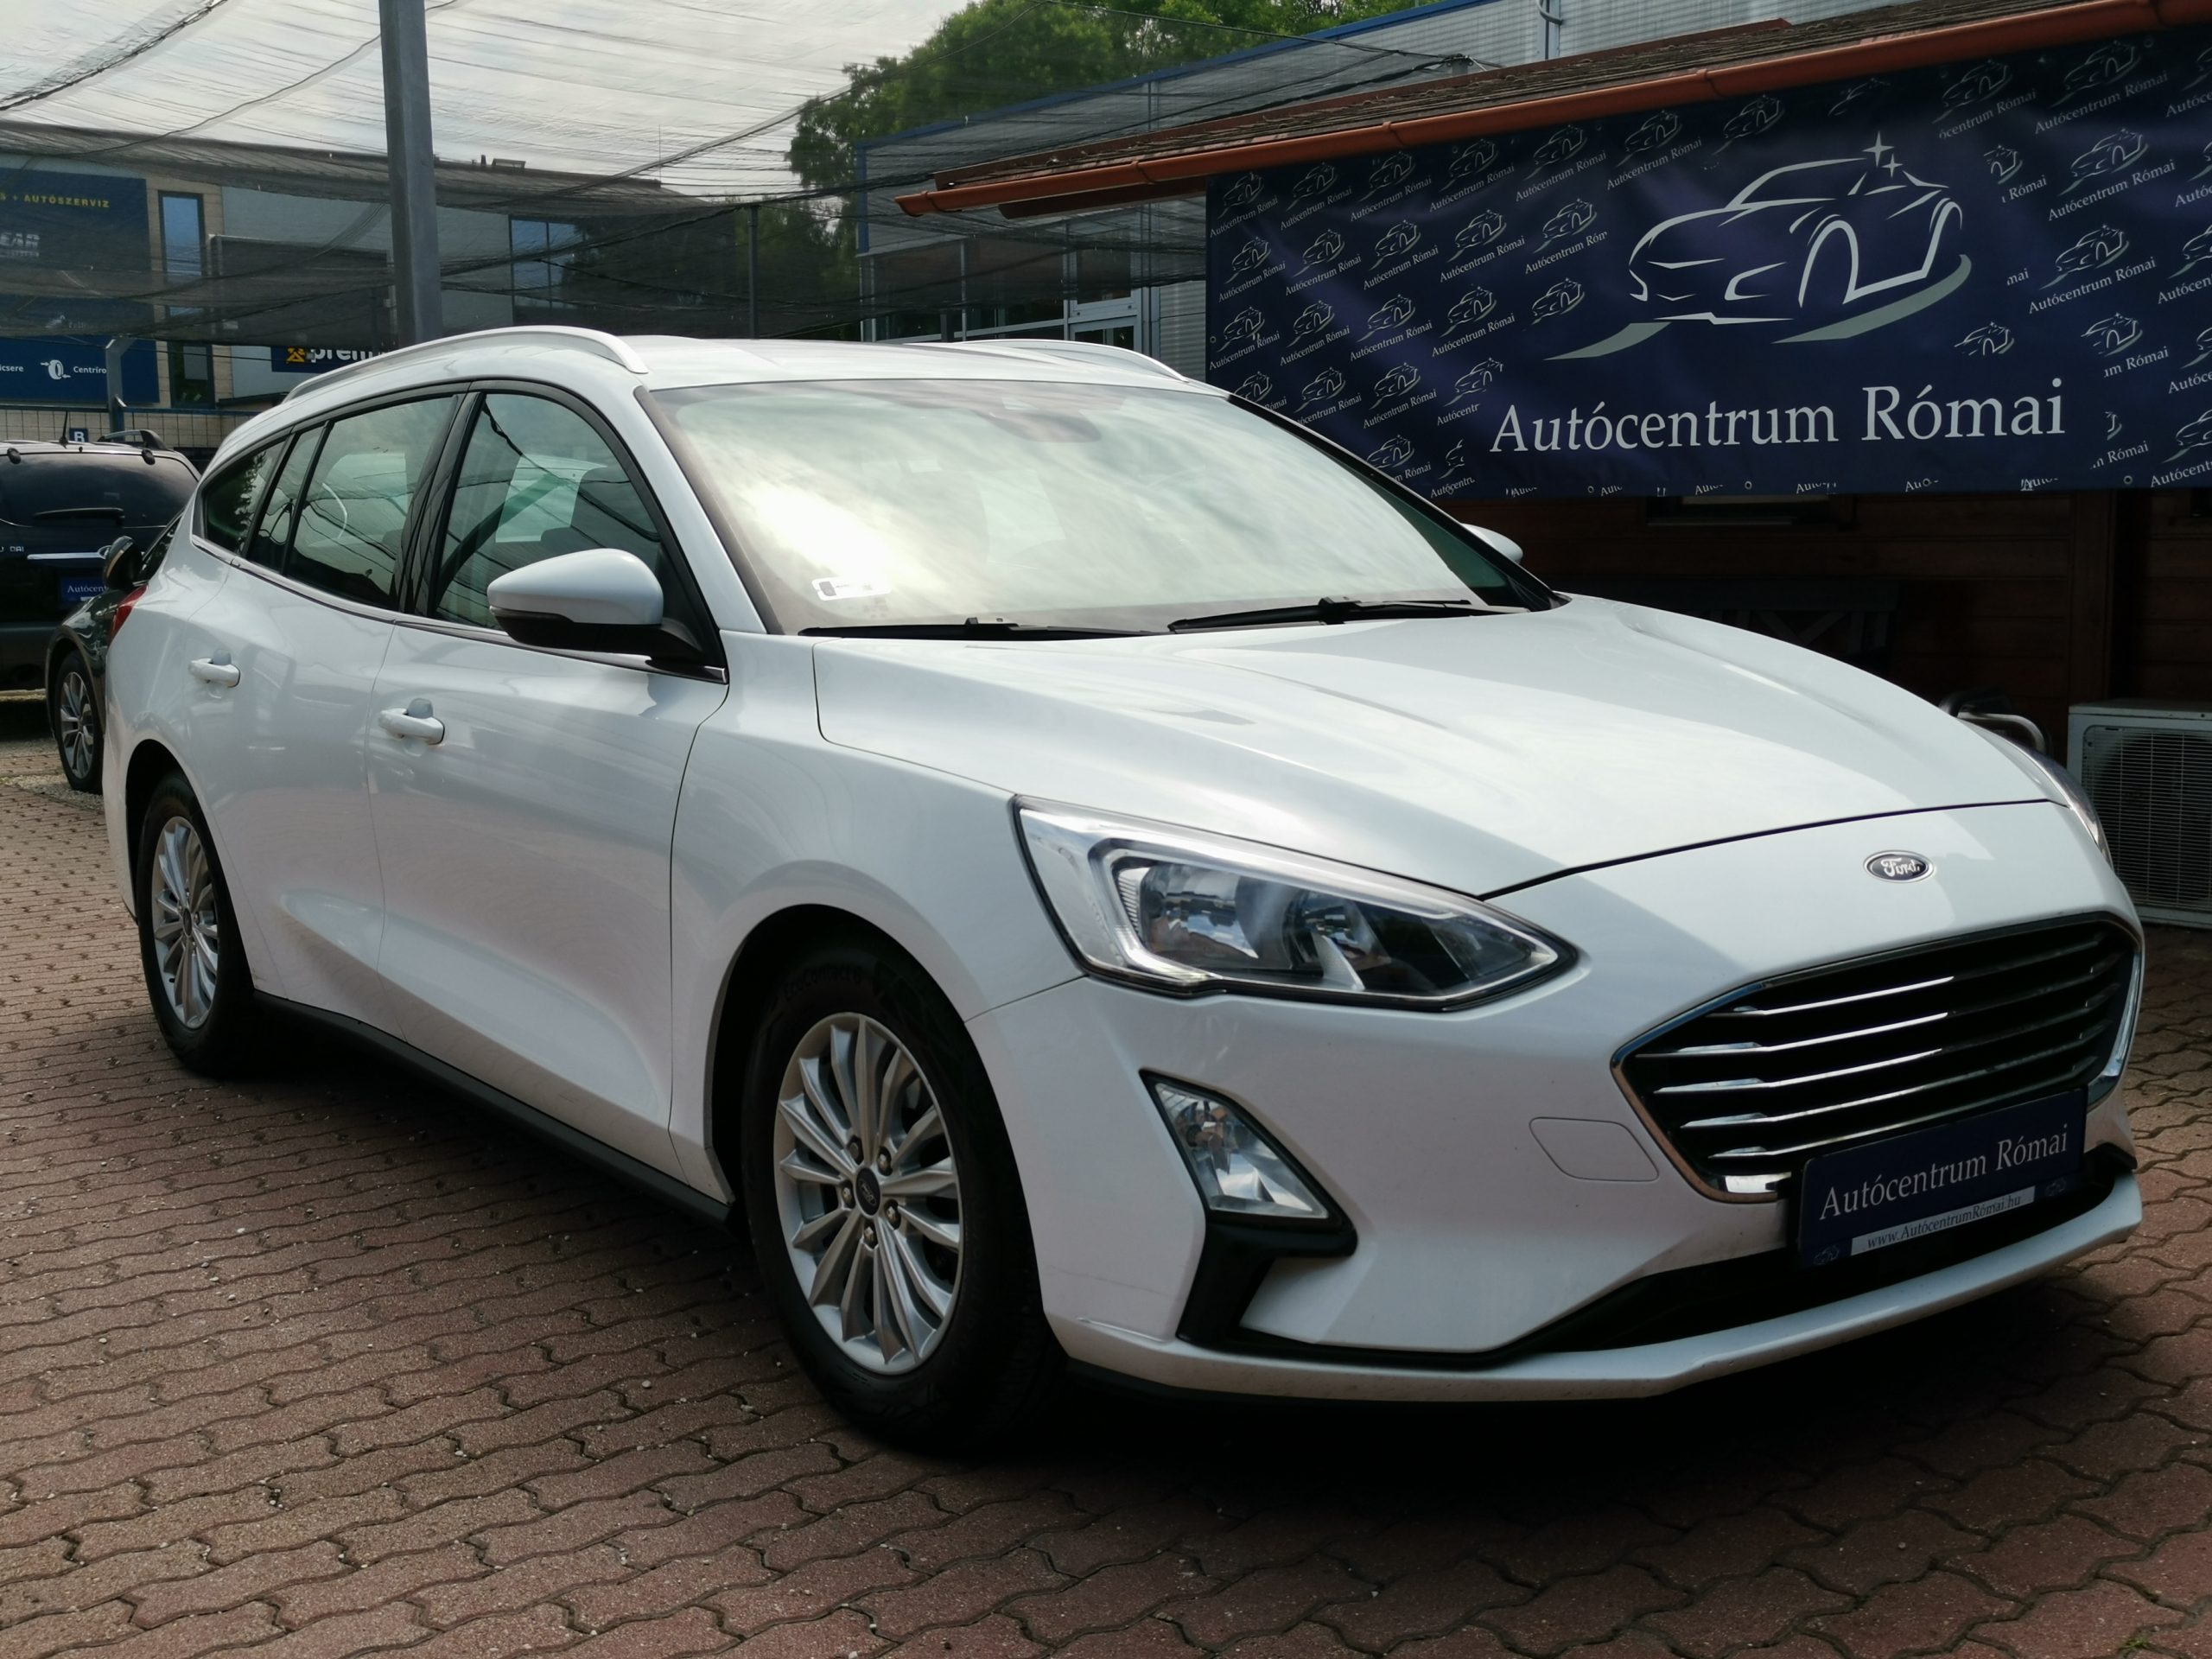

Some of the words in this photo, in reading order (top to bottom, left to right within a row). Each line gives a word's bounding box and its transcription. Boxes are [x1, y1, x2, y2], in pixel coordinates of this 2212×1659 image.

[2034, 92, 2122, 134] Autócentrum
[2125, 70, 2169, 98] Római
[1515, 167, 1574, 202] Autócentrum
[1575, 150, 1607, 172] Római
[1606, 154, 1669, 191] Autócentrum
[1670, 137, 1703, 163] Római
[23, 193, 110, 208] AUTÓSZERVIZ
[1350, 190, 1403, 222] Autócentrum
[1405, 176, 1433, 199] Római
[1429, 177, 1484, 213] Autócentrum
[1486, 165, 1516, 183] Római
[2009, 175, 2048, 201] Római
[2048, 180, 2129, 221] Autócentrum
[2131, 159, 2176, 187] Római
[1210, 208, 1256, 238] Autócentrum
[1280, 200, 1325, 231] Autócentrum
[1327, 187, 1352, 205] Római
[1285, 269, 1338, 296] Autócentrum
[1338, 254, 1362, 274] Római
[1363, 260, 1412, 290] Autócentrum
[1411, 245, 1439, 268] Római
[1440, 251, 1496, 283] Autócentrum
[1497, 235, 1526, 256] Római
[1525, 242, 1585, 275] Autócentrum
[1218, 275, 1263, 302] Autócentrum
[1262, 262, 1286, 280] Római
[2029, 276, 2113, 315] Autócentrum
[2115, 257, 2157, 282] Római
[1209, 344, 1255, 371] Autócentrum
[1255, 330, 1281, 350] Római
[1280, 337, 1325, 366] Autócentrum
[1325, 325, 1351, 345] Római
[1350, 334, 1404, 361] Autócentrum
[1405, 320, 1433, 340] Római
[1432, 327, 1487, 358] Autócentrum
[1488, 313, 1516, 333] Római
[2126, 346, 2170, 371] Római
[1338, 391, 1363, 410] Római
[1363, 399, 1410, 429] Autócentrum
[1409, 388, 1438, 407] Római
[1489, 400, 1840, 454] Autócentrum
[1860, 377, 2066, 442] Római
[1404, 461, 1432, 480] Római
[2107, 440, 2150, 464] Római
[1880, 857, 1920, 877] Ford
[1819, 1154, 1986, 1221] Autócentrum
[1996, 1123, 2068, 1172] Római
